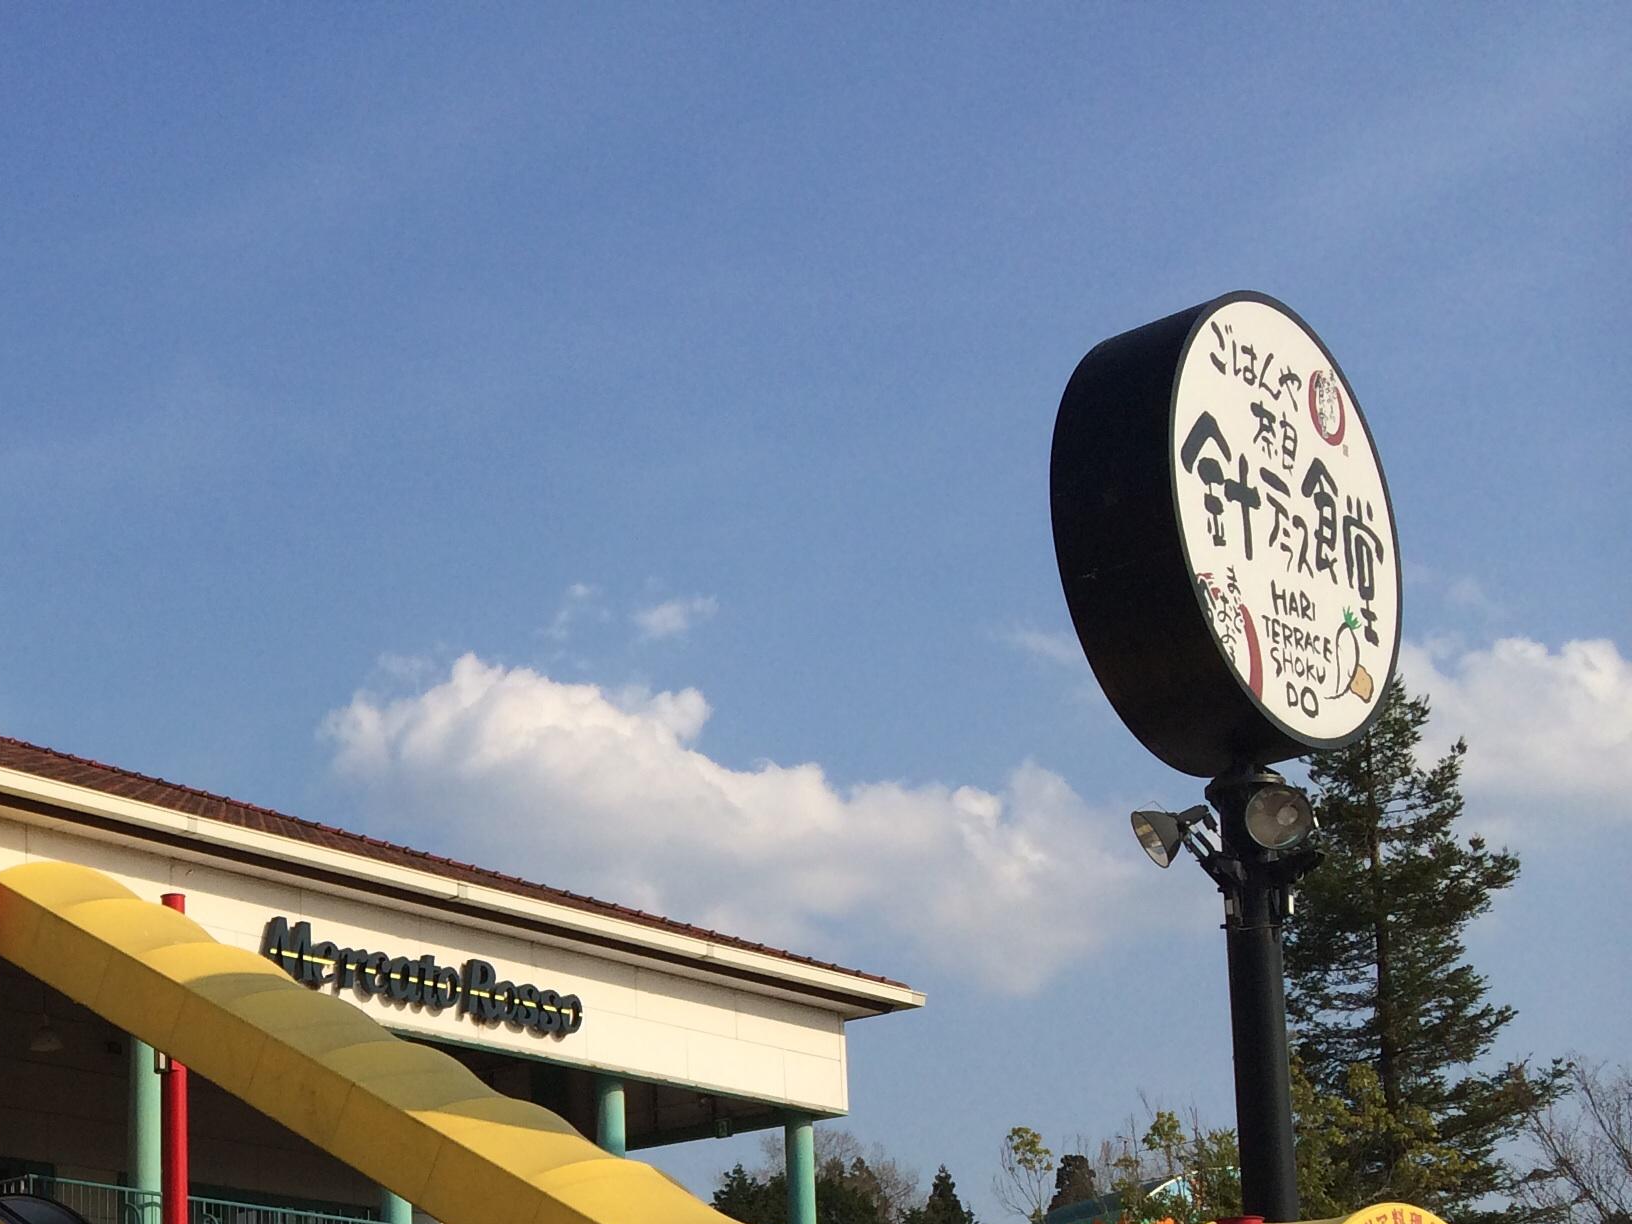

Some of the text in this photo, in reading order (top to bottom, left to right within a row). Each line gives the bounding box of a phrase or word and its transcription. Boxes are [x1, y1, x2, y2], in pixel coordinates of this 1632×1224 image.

[1210, 321, 1302, 411] ごはんや
[1270, 580, 1317, 622] HARI
[1261, 615, 1333, 663] TERRACE
[1269, 646, 1326, 685] SHOKU
[1287, 685, 1319, 718] DO
[461, 959, 583, 1039] Rosso
